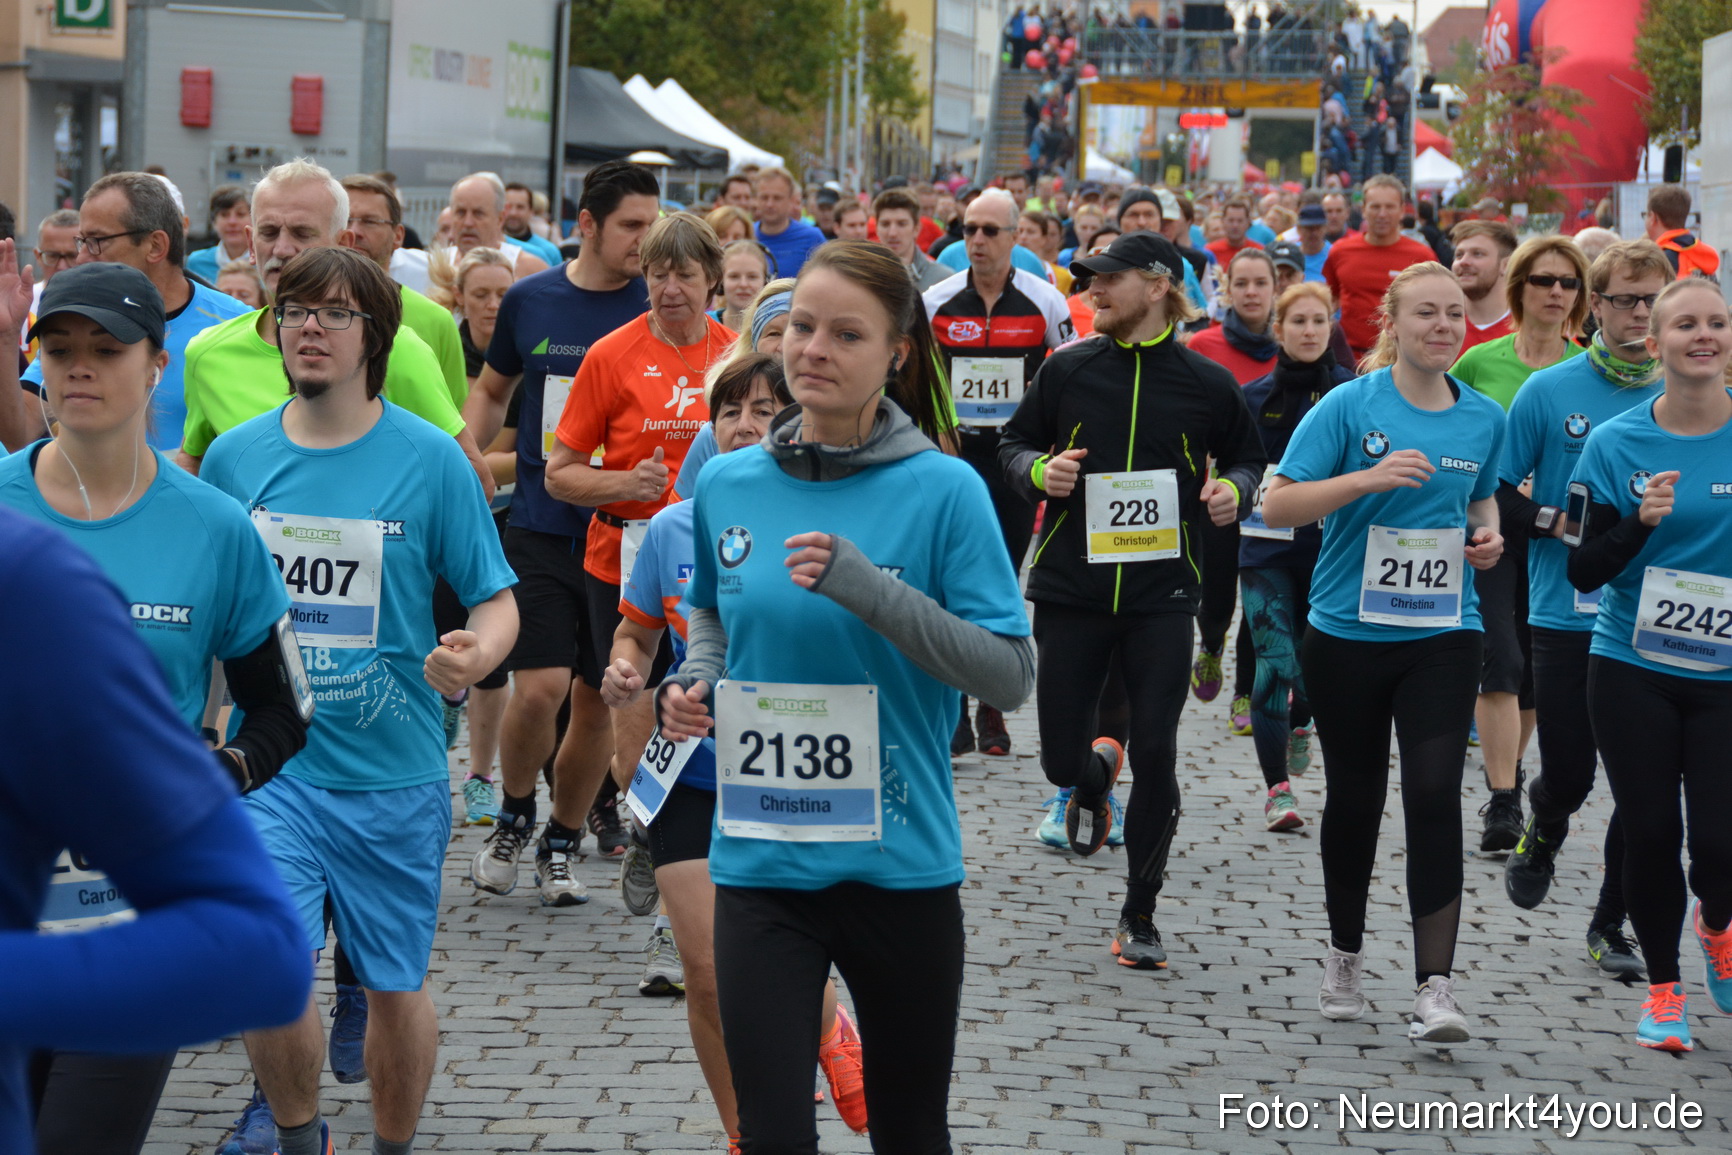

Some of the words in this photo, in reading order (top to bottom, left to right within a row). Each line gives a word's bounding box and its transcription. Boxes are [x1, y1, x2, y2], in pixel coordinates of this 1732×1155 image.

[962, 378, 1009, 399] 2141
[977, 406, 997, 414] Klaus
[1109, 498, 1160, 527] 228
[295, 527, 341, 541] BOCK
[1113, 535, 1158, 546] Christoph
[1378, 558, 1448, 588] 2142
[1390, 597, 1435, 609] Christina
[1653, 599, 1732, 639] 2242
[1662, 638, 1717, 657] Katharina
[302, 647, 339, 670] 18.
[772, 698, 828, 713] BOCK
[739, 729, 853, 780] 2138
[760, 794, 831, 813] Christina
